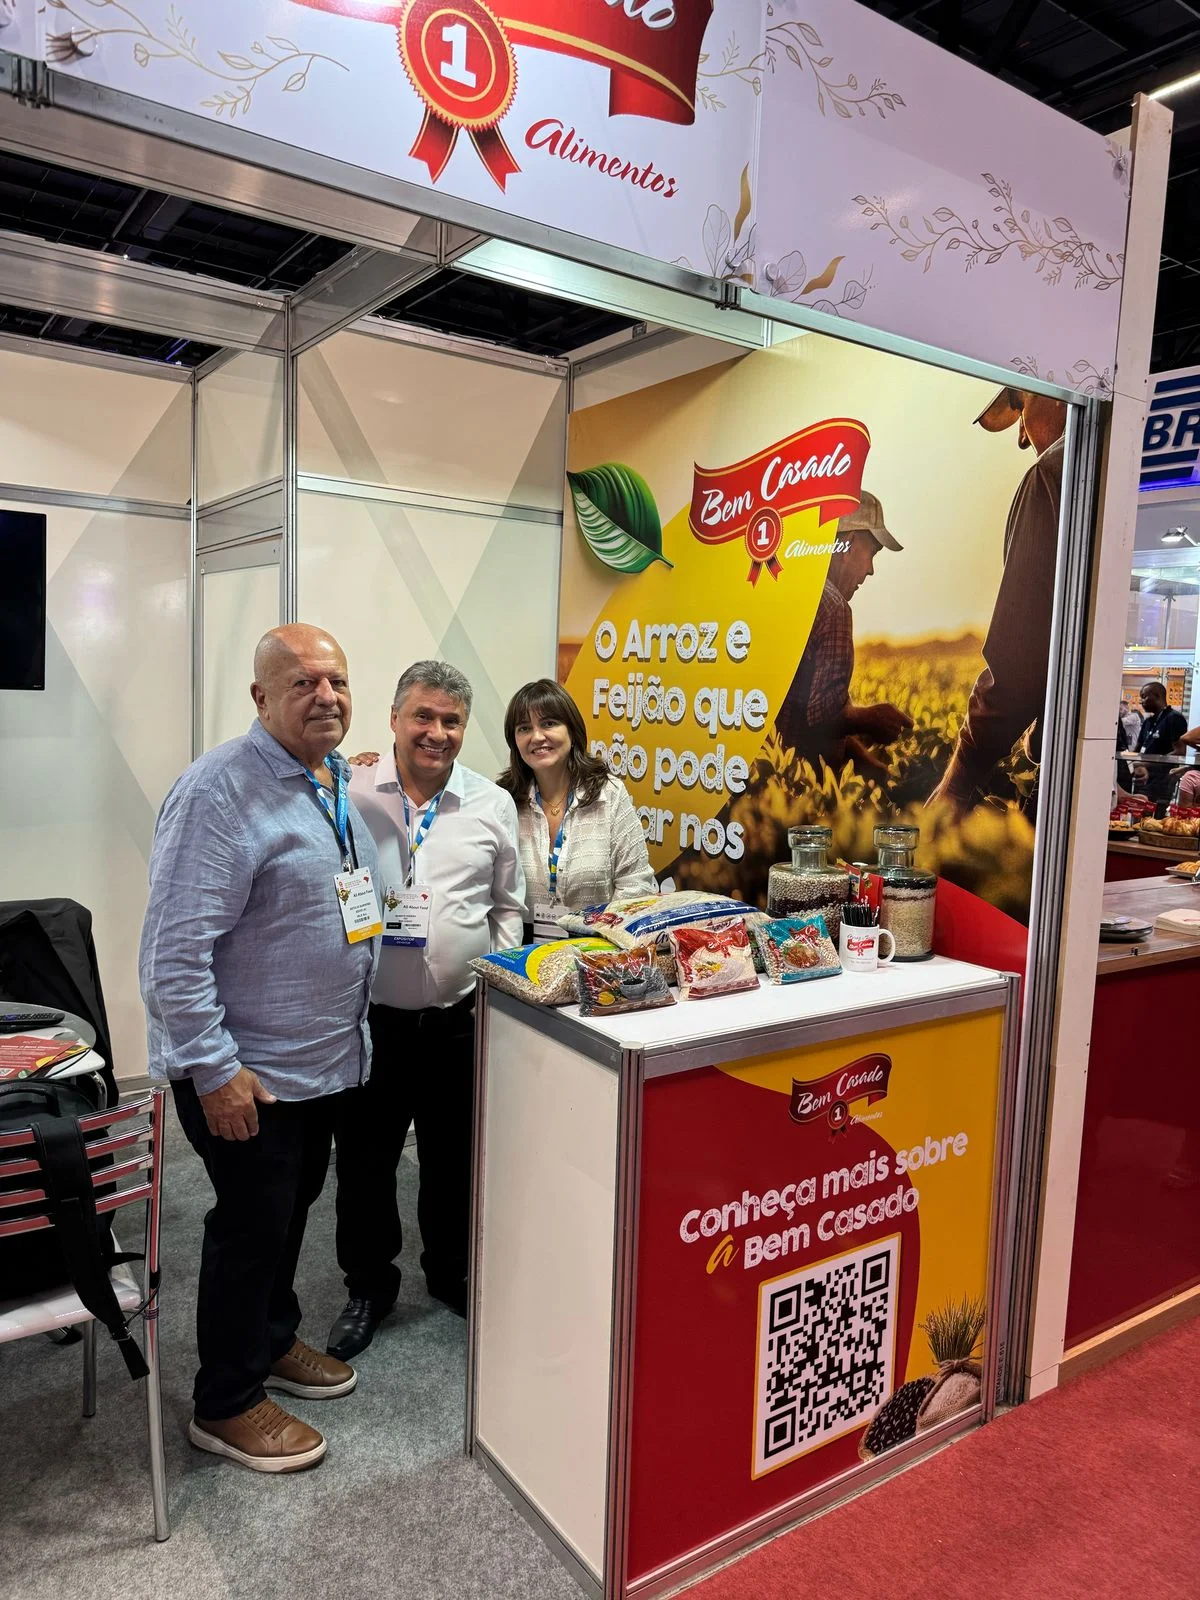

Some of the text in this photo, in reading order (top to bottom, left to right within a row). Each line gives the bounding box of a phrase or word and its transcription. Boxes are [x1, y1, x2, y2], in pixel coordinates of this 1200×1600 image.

[441, 23, 477, 89] 1
[524, 118, 680, 199] Alimentos
[700, 442, 851, 526] Bem Casado
[757, 521, 770, 546] 1
[785, 538, 851, 559] Alimentos
[594, 619, 752, 661] O Arroz e
[593, 672, 768, 735] Feijão que
[590, 732, 749, 793] não pode
[680, 812, 745, 860] nos
[797, 1065, 884, 1114] Bem Casado
[834, 1107, 842, 1121] 1
[679, 1131, 968, 1243] Conheça mais sobre
[706, 1184, 920, 1275] a Bem Casado
